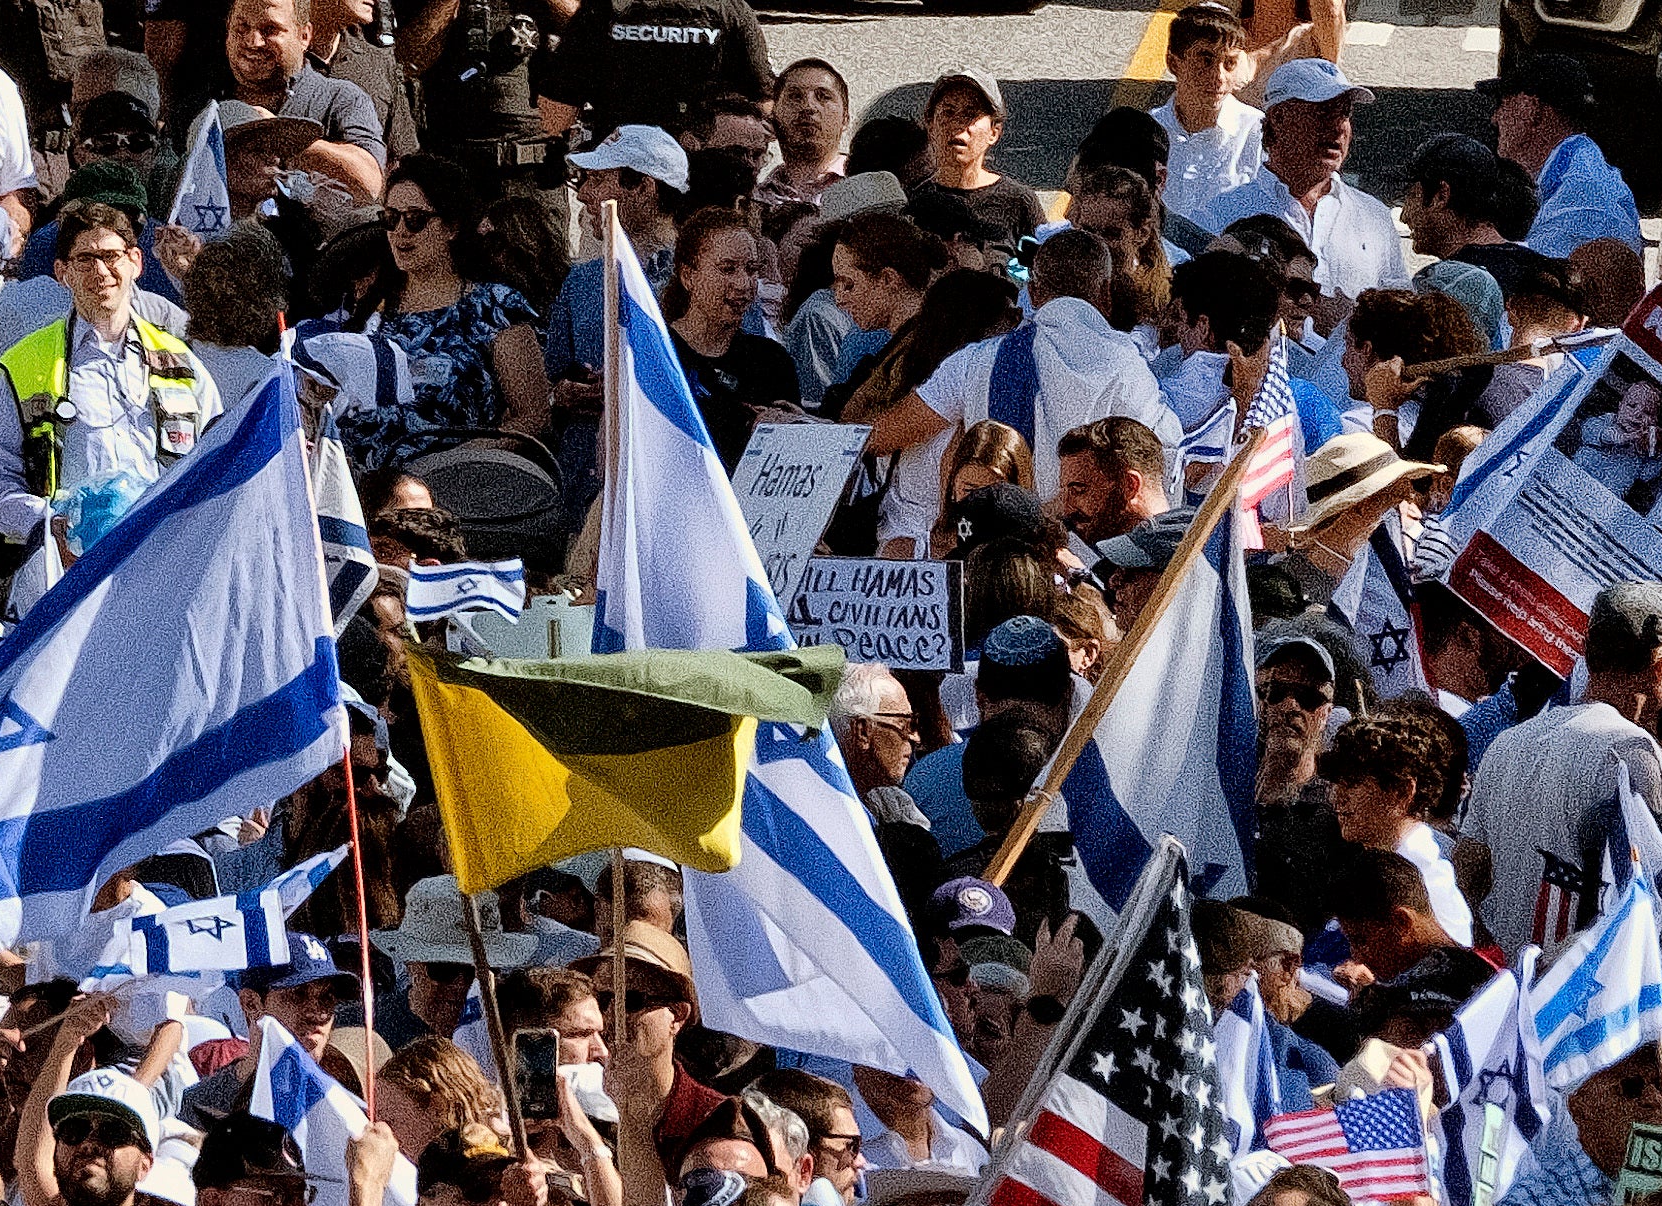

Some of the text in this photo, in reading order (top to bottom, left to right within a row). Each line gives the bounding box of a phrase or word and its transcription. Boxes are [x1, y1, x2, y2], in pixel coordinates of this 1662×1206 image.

[611, 24, 720, 44] SECURITY
[749, 453, 822, 498] Hamas
[851, 566, 935, 599] HAMAS
[827, 600, 940, 630] CIVILIANS
[1500, 595, 1530, 622] help
[1525, 615, 1557, 644] bring
